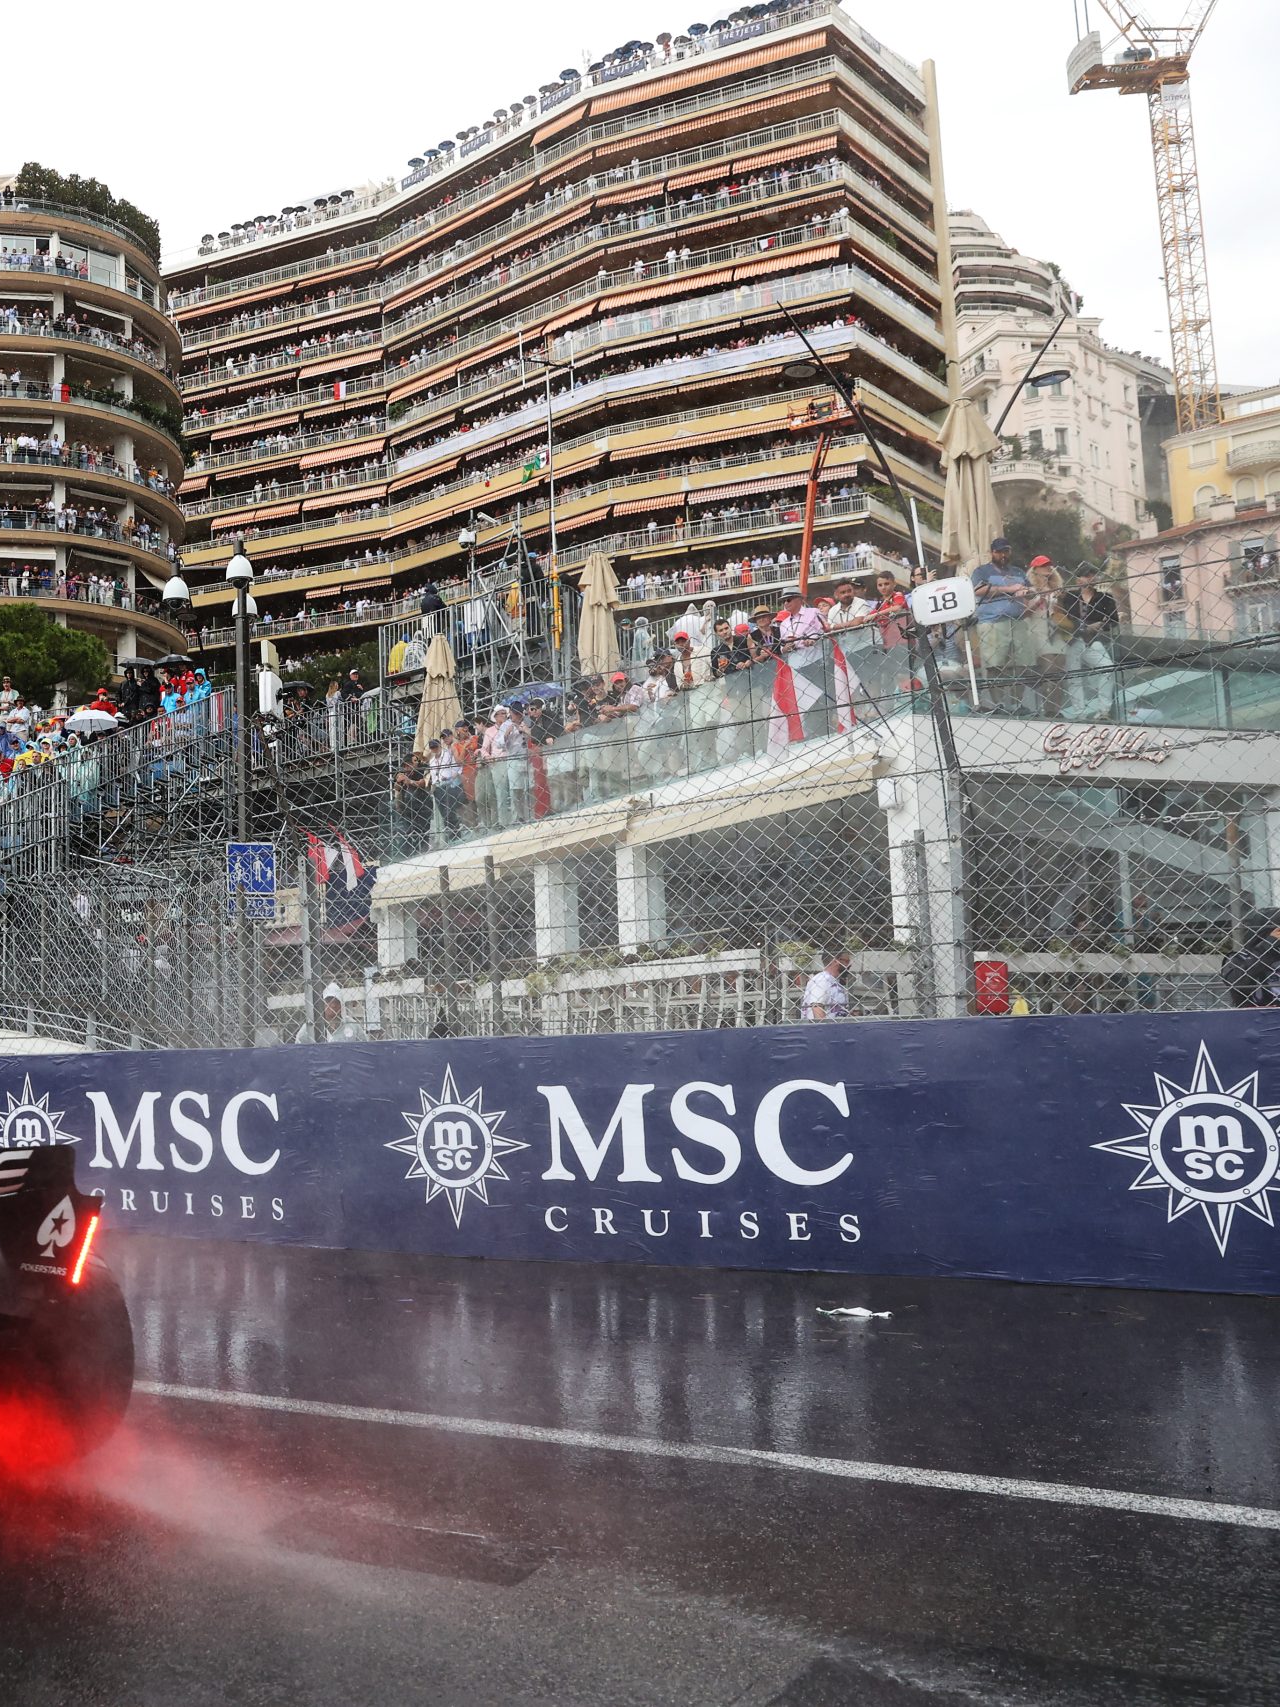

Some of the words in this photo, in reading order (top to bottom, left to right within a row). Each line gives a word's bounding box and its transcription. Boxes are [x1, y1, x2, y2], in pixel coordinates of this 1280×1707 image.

[723, 23, 761, 40] NETJETS
[605, 60, 640, 77] NETJETS
[462, 133, 487, 153] NETJETS
[403, 168, 427, 186] NETJETS
[928, 591, 958, 613] 18
[86, 1091, 281, 1176] MSC
[537, 1080, 854, 1186] MSC
[90, 1187, 285, 1221] CRUISES
[545, 1206, 862, 1244] CRUISES
[20, 1262, 68, 1276] POKERSTARS
